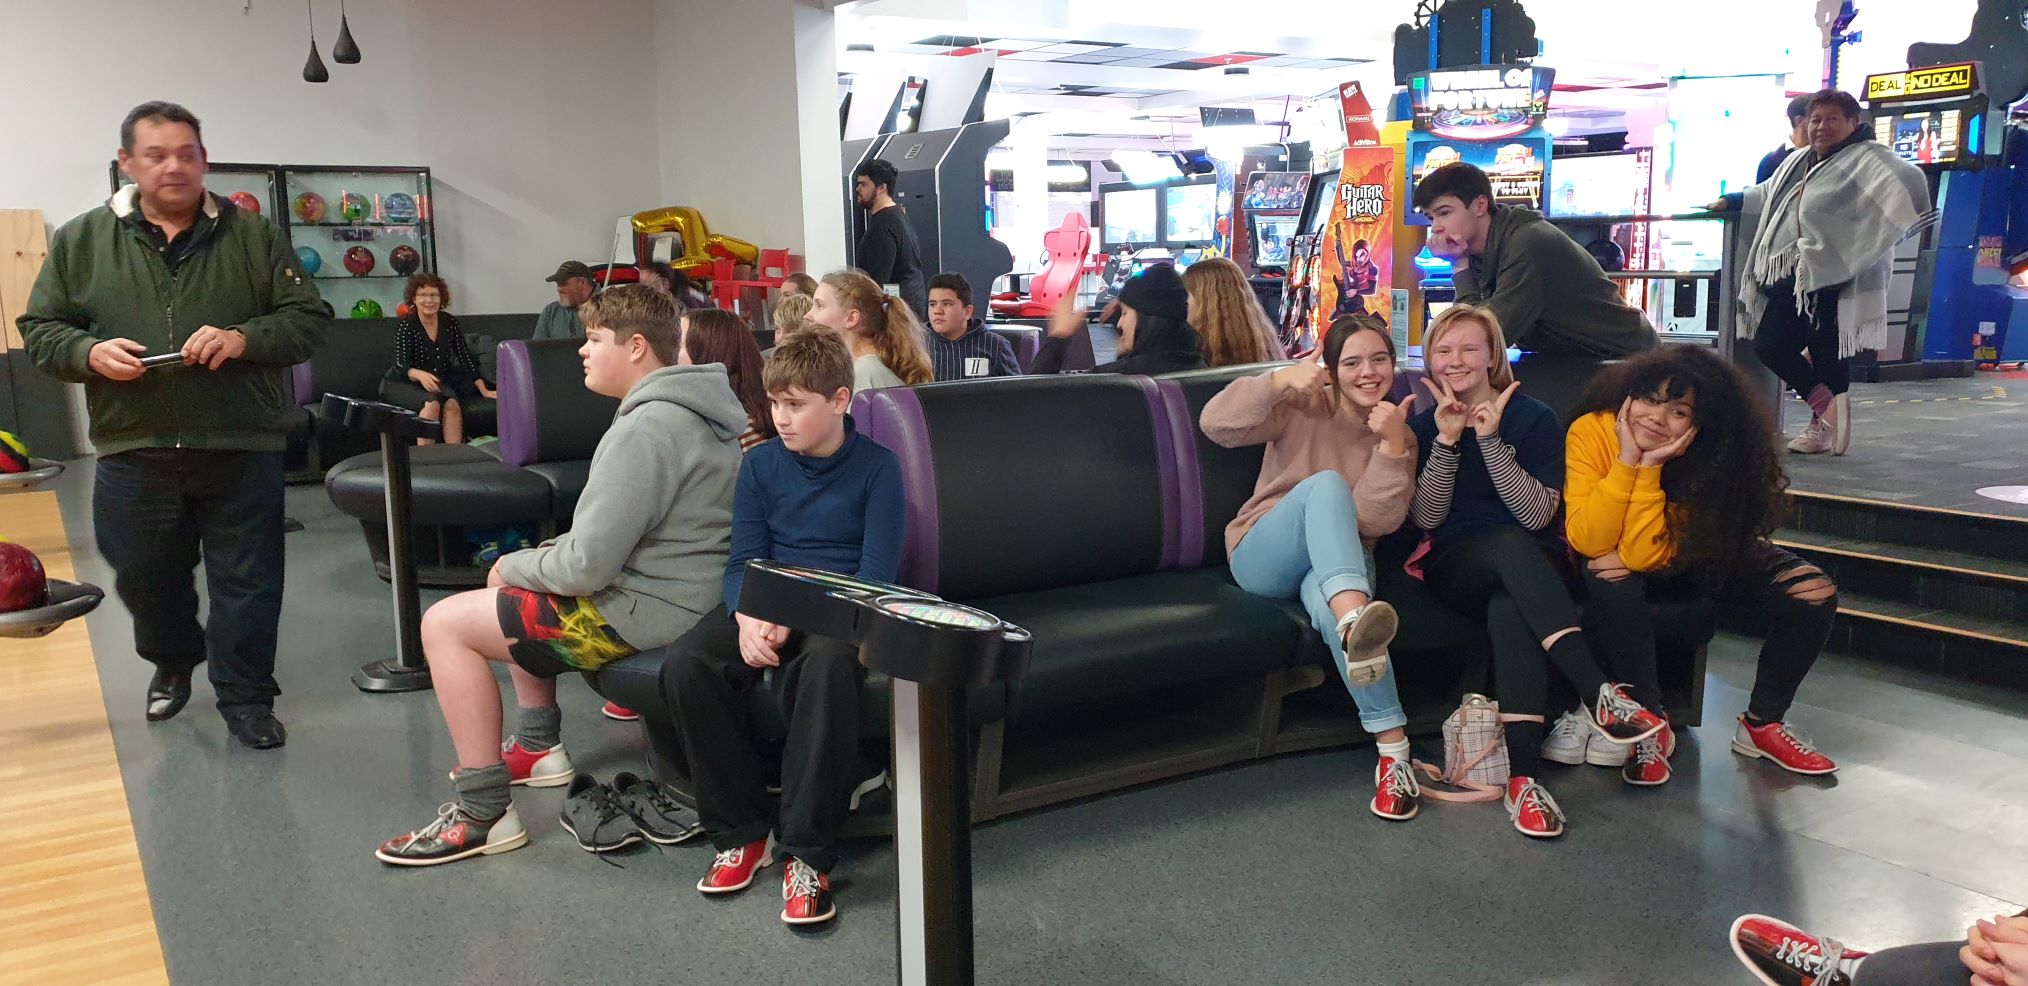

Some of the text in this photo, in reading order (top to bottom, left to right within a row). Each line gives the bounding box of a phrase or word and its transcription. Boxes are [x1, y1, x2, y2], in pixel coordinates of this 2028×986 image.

[1870, 80, 1902, 92] DEAL
[1911, 75, 1931, 89] NO
[1931, 71, 1967, 87] DEAL
